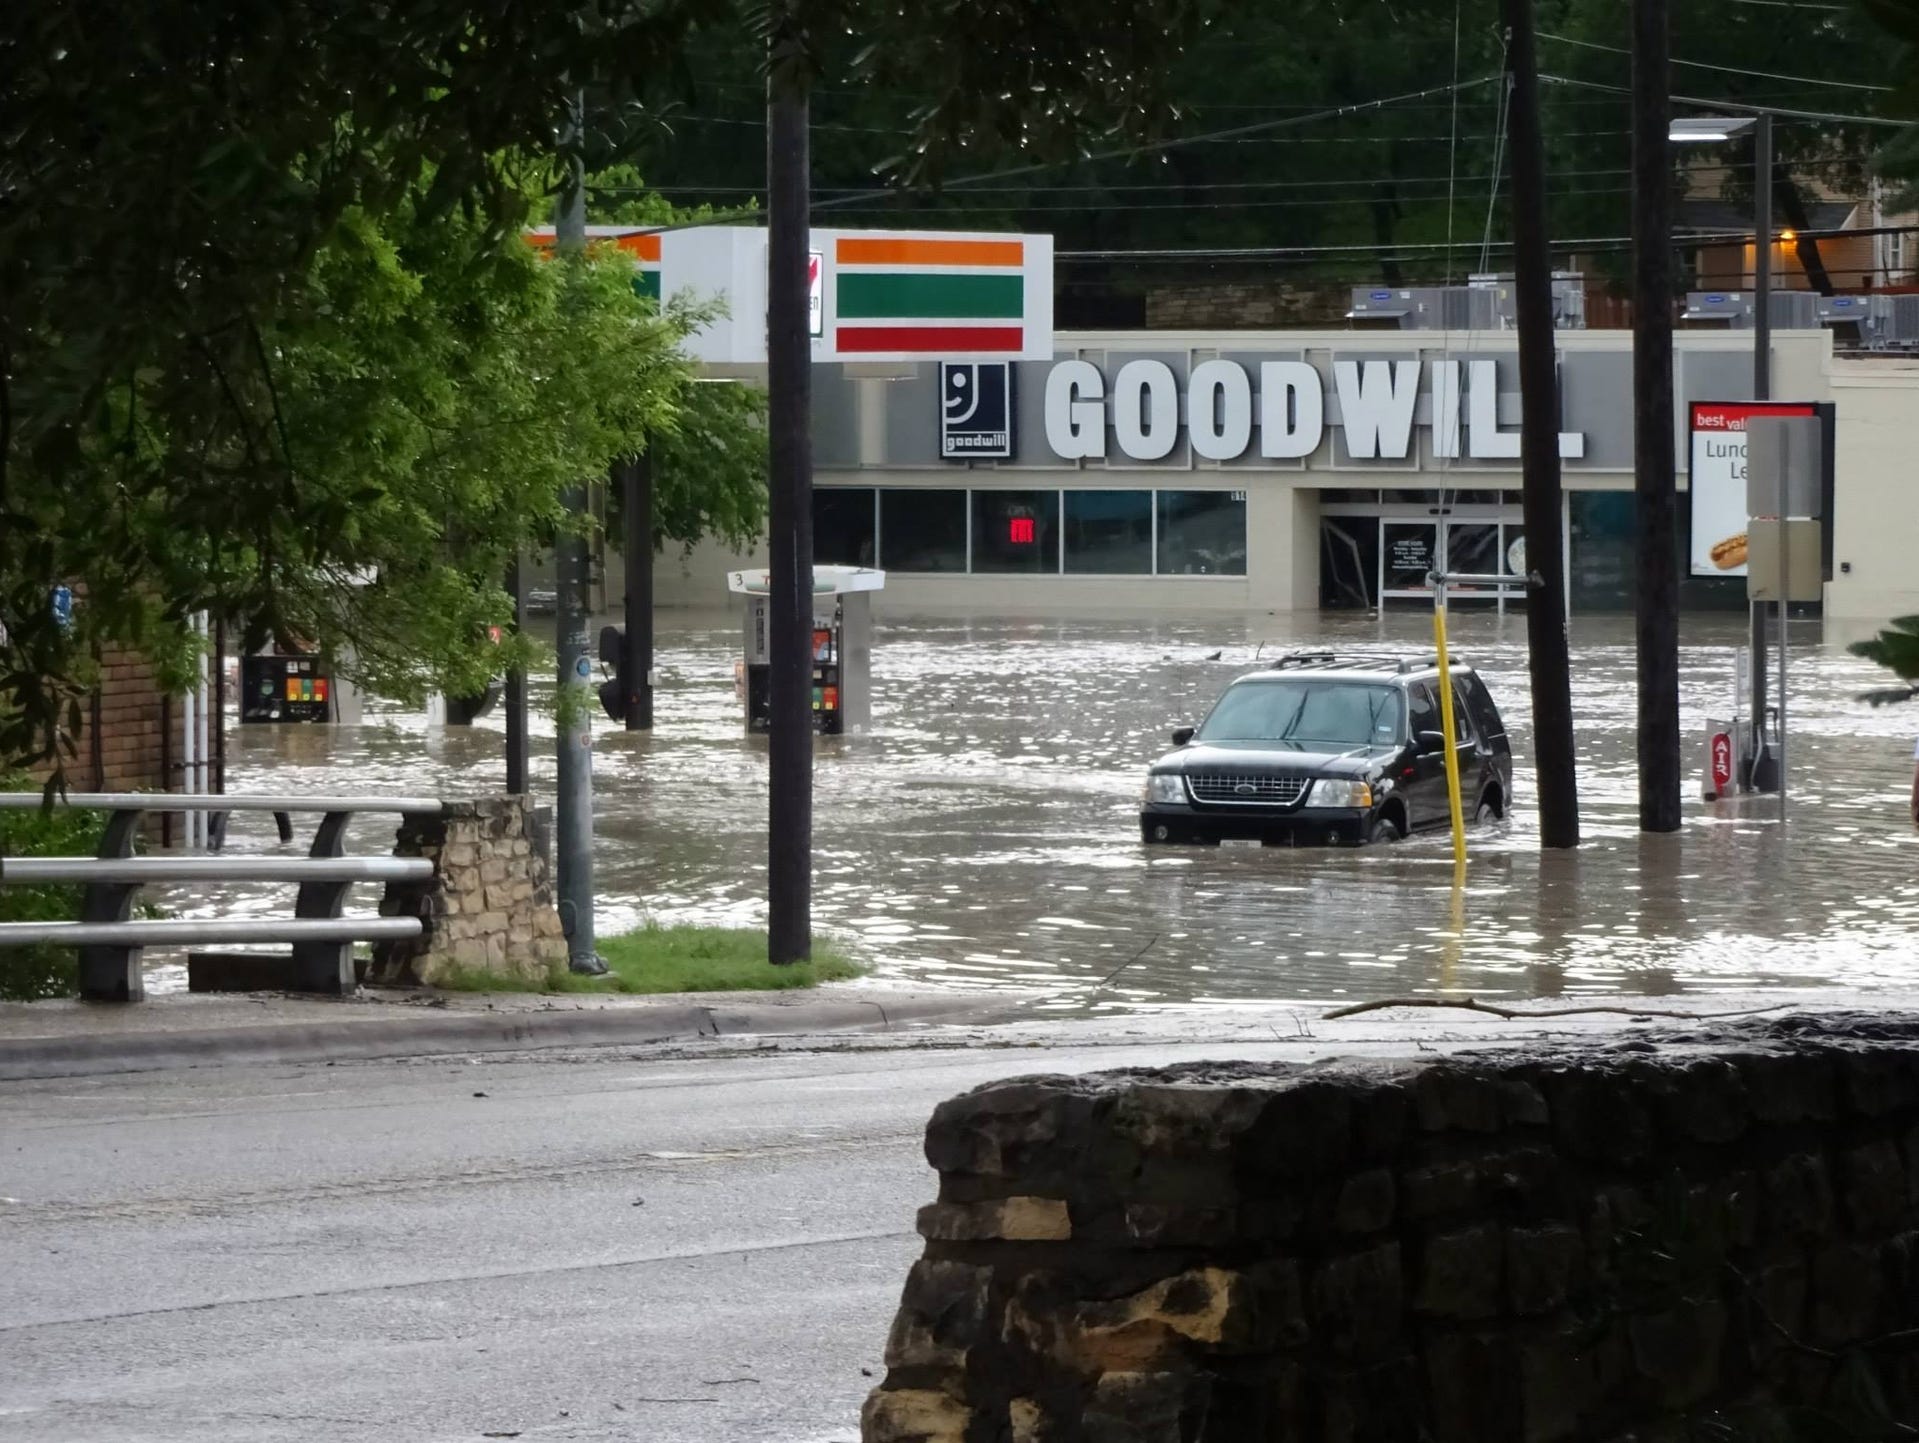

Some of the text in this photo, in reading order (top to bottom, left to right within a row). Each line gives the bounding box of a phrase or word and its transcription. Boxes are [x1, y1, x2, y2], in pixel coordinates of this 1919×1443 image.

[1044, 359, 1585, 459] GOODWIL
[1697, 412, 1748, 430] best val
[947, 433, 1005, 451] goodwill
[1706, 440, 1748, 458] Lunc
[1731, 461, 1748, 480] Le
[735, 573, 743, 586] 3
[1715, 740, 1728, 776] AIR
